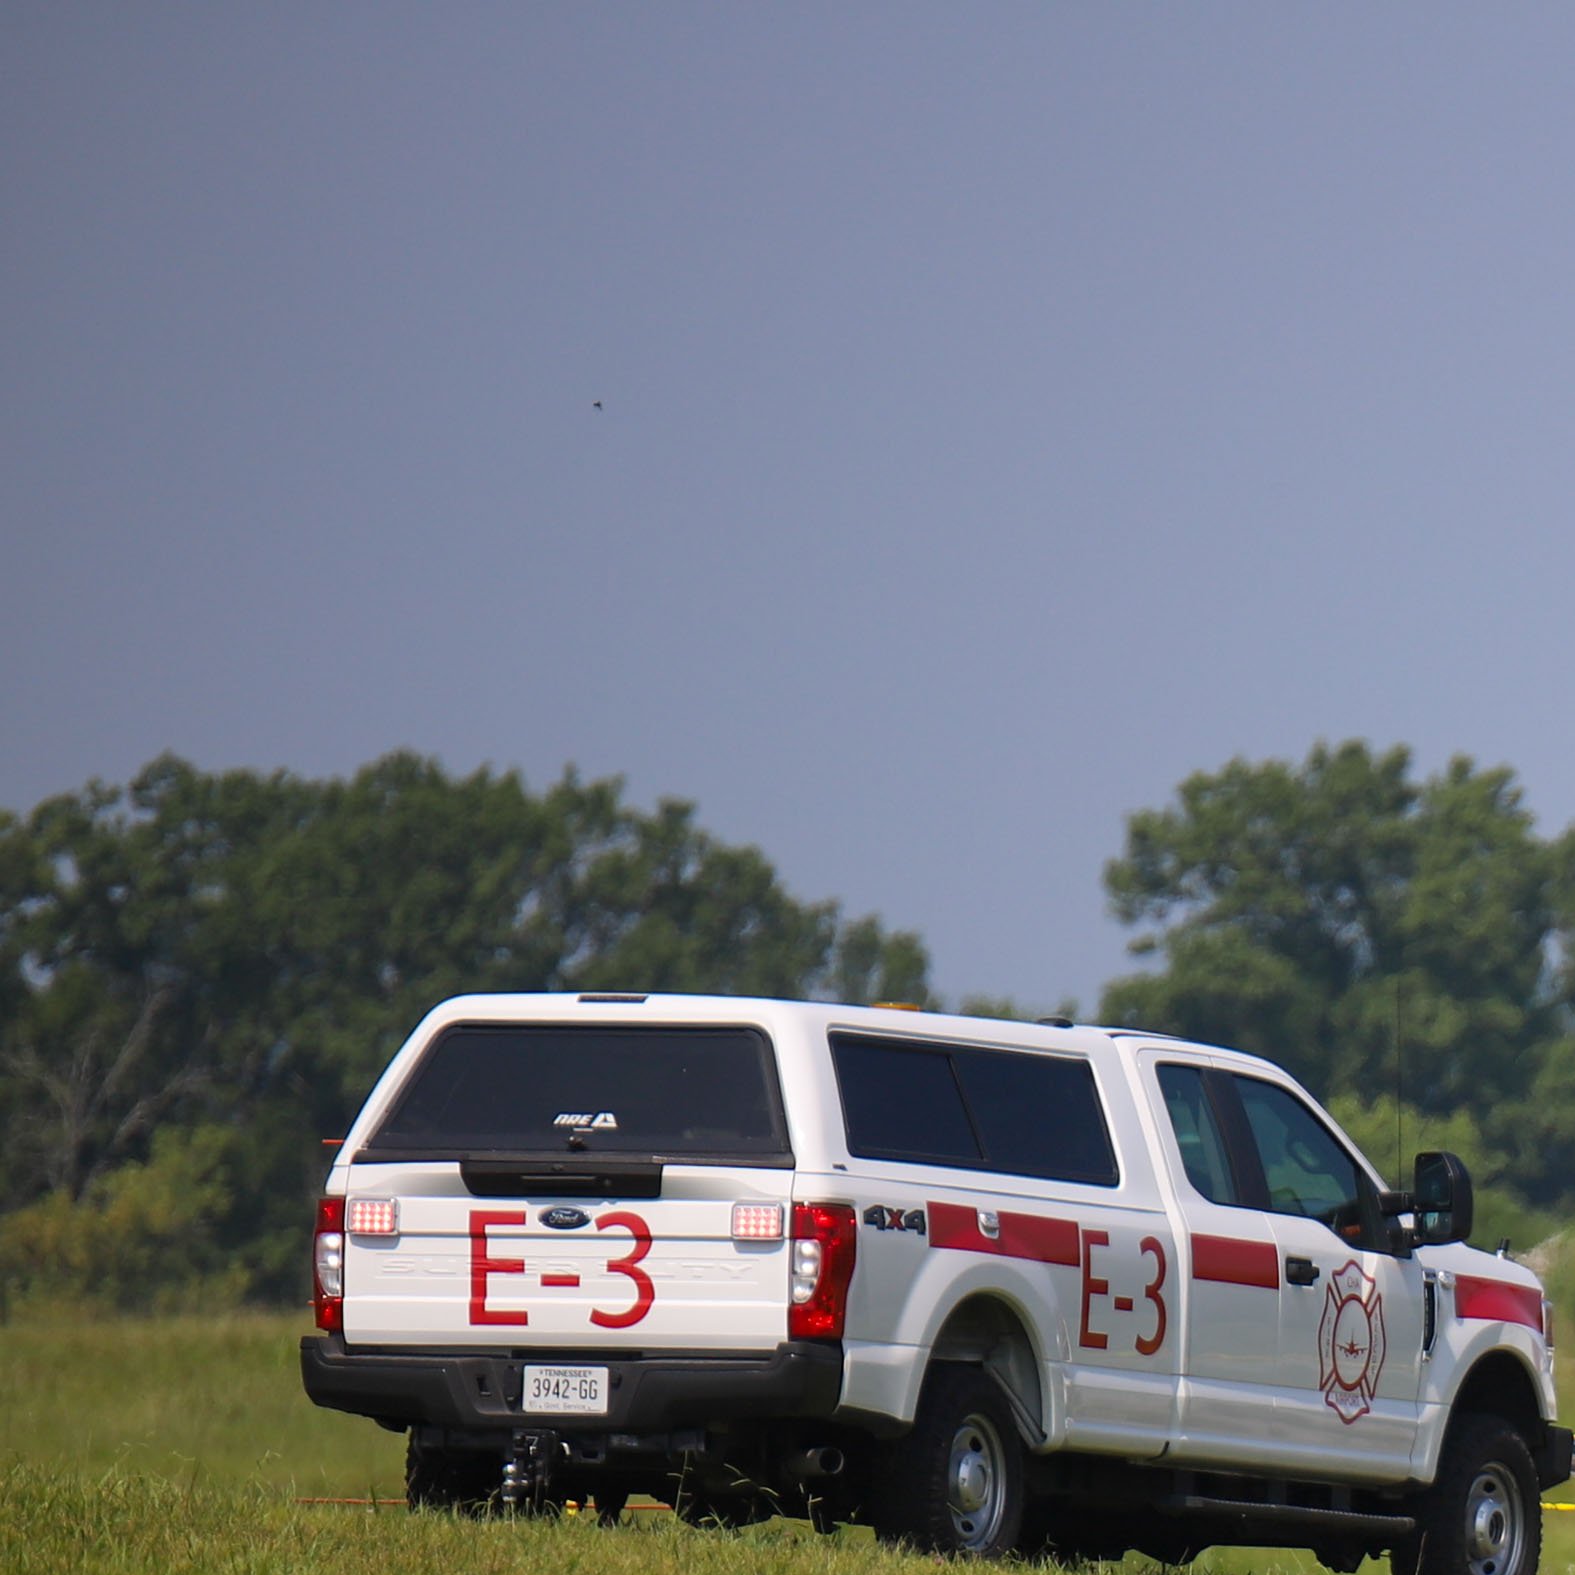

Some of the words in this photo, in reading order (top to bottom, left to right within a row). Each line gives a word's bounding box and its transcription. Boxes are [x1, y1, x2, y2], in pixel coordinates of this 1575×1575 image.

[468, 1209, 656, 1328] E-3
[1079, 1228, 1167, 1356] E-3
[532, 1378, 598, 1399] 3942-GG
